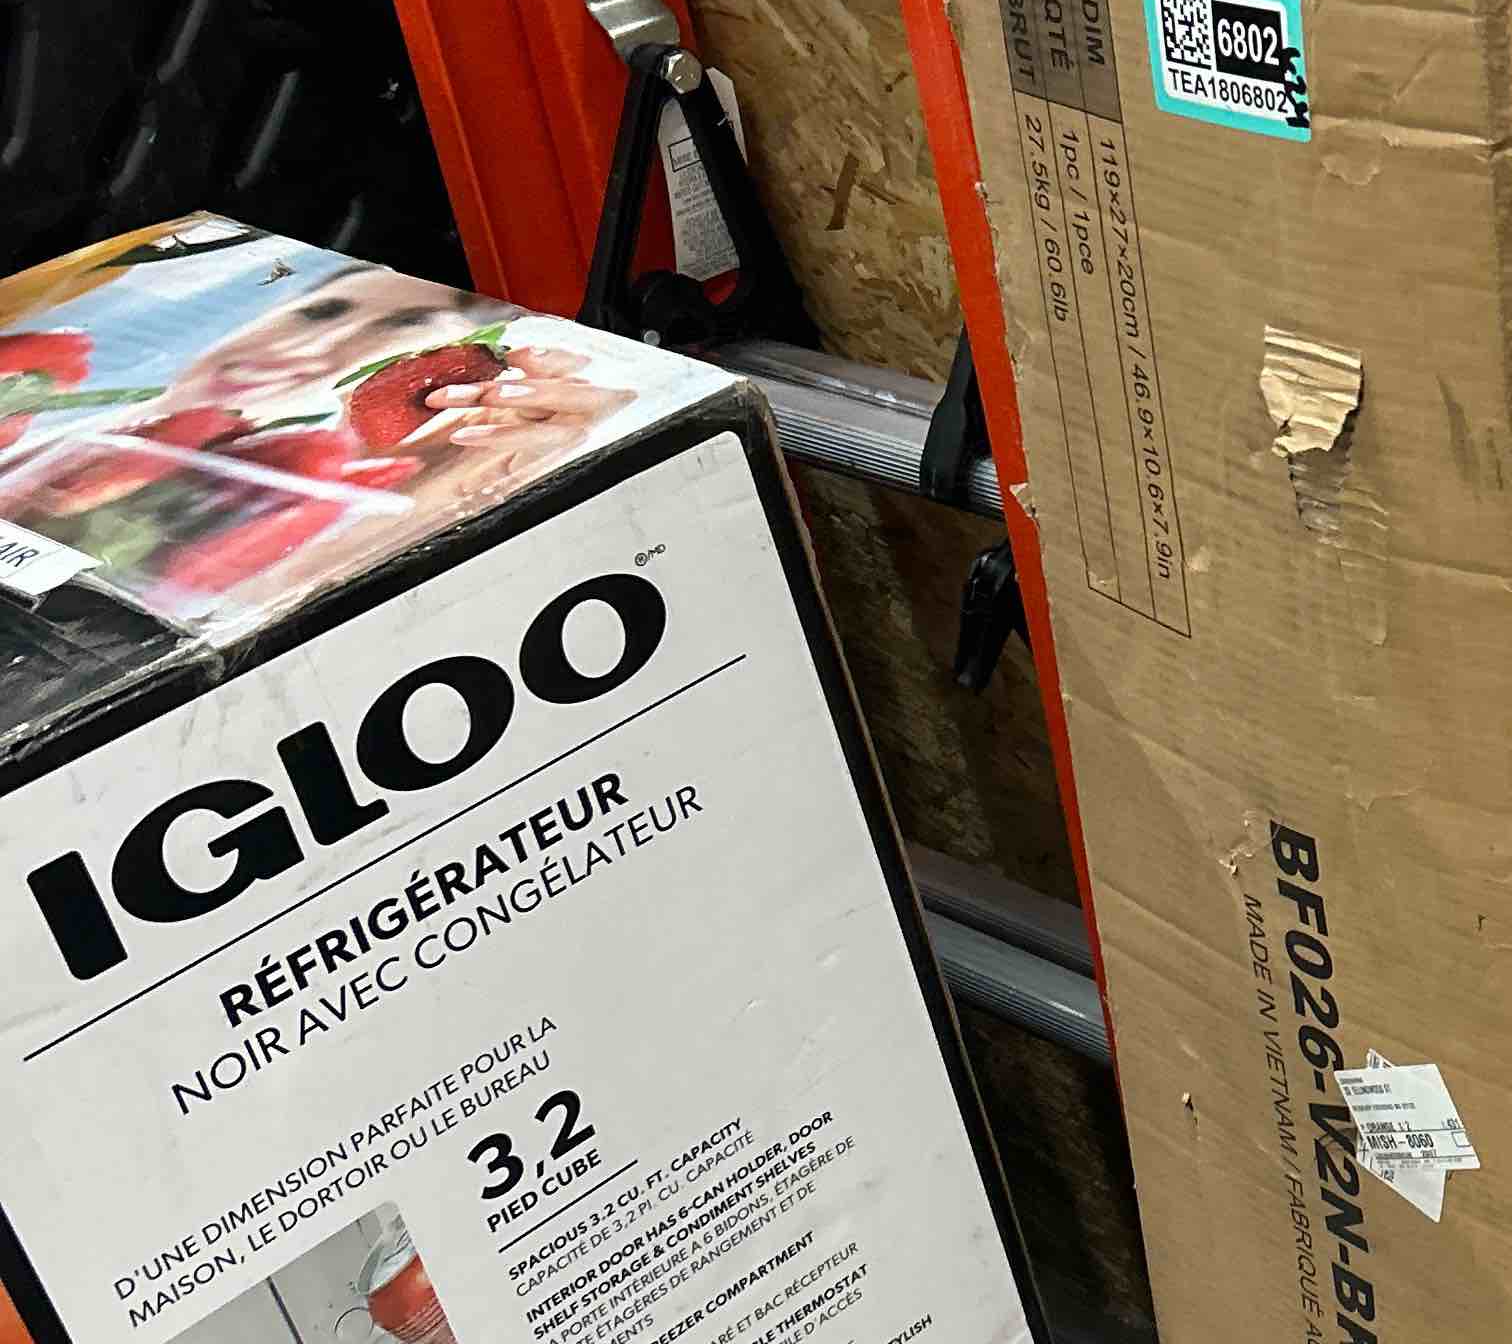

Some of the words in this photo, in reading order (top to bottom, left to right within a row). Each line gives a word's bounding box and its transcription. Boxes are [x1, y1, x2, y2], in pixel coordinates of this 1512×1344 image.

[1167, 67, 1289, 114] TEA1806802
[1217, 17, 1280, 66] 6802
[1024, 114, 1051, 211] 27.5kg
[1061, 128, 1081, 180] 1pc
[1071, 210, 1095, 276] 1pce
[27, 573, 668, 981] IGLOO
[171, 1027, 289, 1116] NOIR
[299, 956, 409, 1046] AVEC
[414, 785, 704, 969] CONGÉLATEUR
[219, 771, 629, 1027] RÉFRIGÉRATEUR
[1242, 892, 1273, 986] MADE
[1256, 987, 1278, 1024] IN
[114, 1234, 201, 1300] D'UNE
[201, 1142, 348, 1245] DIMENSION
[350, 1073, 460, 1153] PARFAITE
[459, 1033, 527, 1084] POUR
[527, 1016, 557, 1043] LA
[467, 1089, 597, 1201] 3,2
[1262, 1029, 1299, 1162] VIETNAM
[1366, 1134, 1396, 1150] MISH
[128, 1247, 245, 1328] MAISON,
[247, 1222, 277, 1252] LE
[278, 1153, 389, 1233] DORTOIR
[390, 1126, 428, 1160] OU
[431, 1107, 459, 1137] LE
[459, 1049, 550, 1118] BUREAU
[486, 1189, 539, 1233] PIED
[541, 1148, 602, 1198] CUBE
[508, 1220, 588, 1281] SPACIOUS
[670, 1117, 741, 1172] CAPACITY
[526, 1268, 598, 1324] INTERIOR
[598, 1236, 645, 1275] DOOR
[645, 1214, 677, 1243] HAS
[678, 1181, 725, 1220] 6-CAN
[788, 1111, 833, 1146] DOOR
[533, 1300, 579, 1340] SHELF
[580, 1252, 652, 1308] STORAGE
[653, 1244, 665, 1259] &
[666, 1181, 753, 1248] CONDIMENT
[755, 1141, 816, 1189] SHELVES
[1284, 1174, 1325, 1320] FABRIQUÉ
[705, 1230, 813, 1314] COMPARTMENT
[775, 1263, 867, 1334] THERMOSTAT
